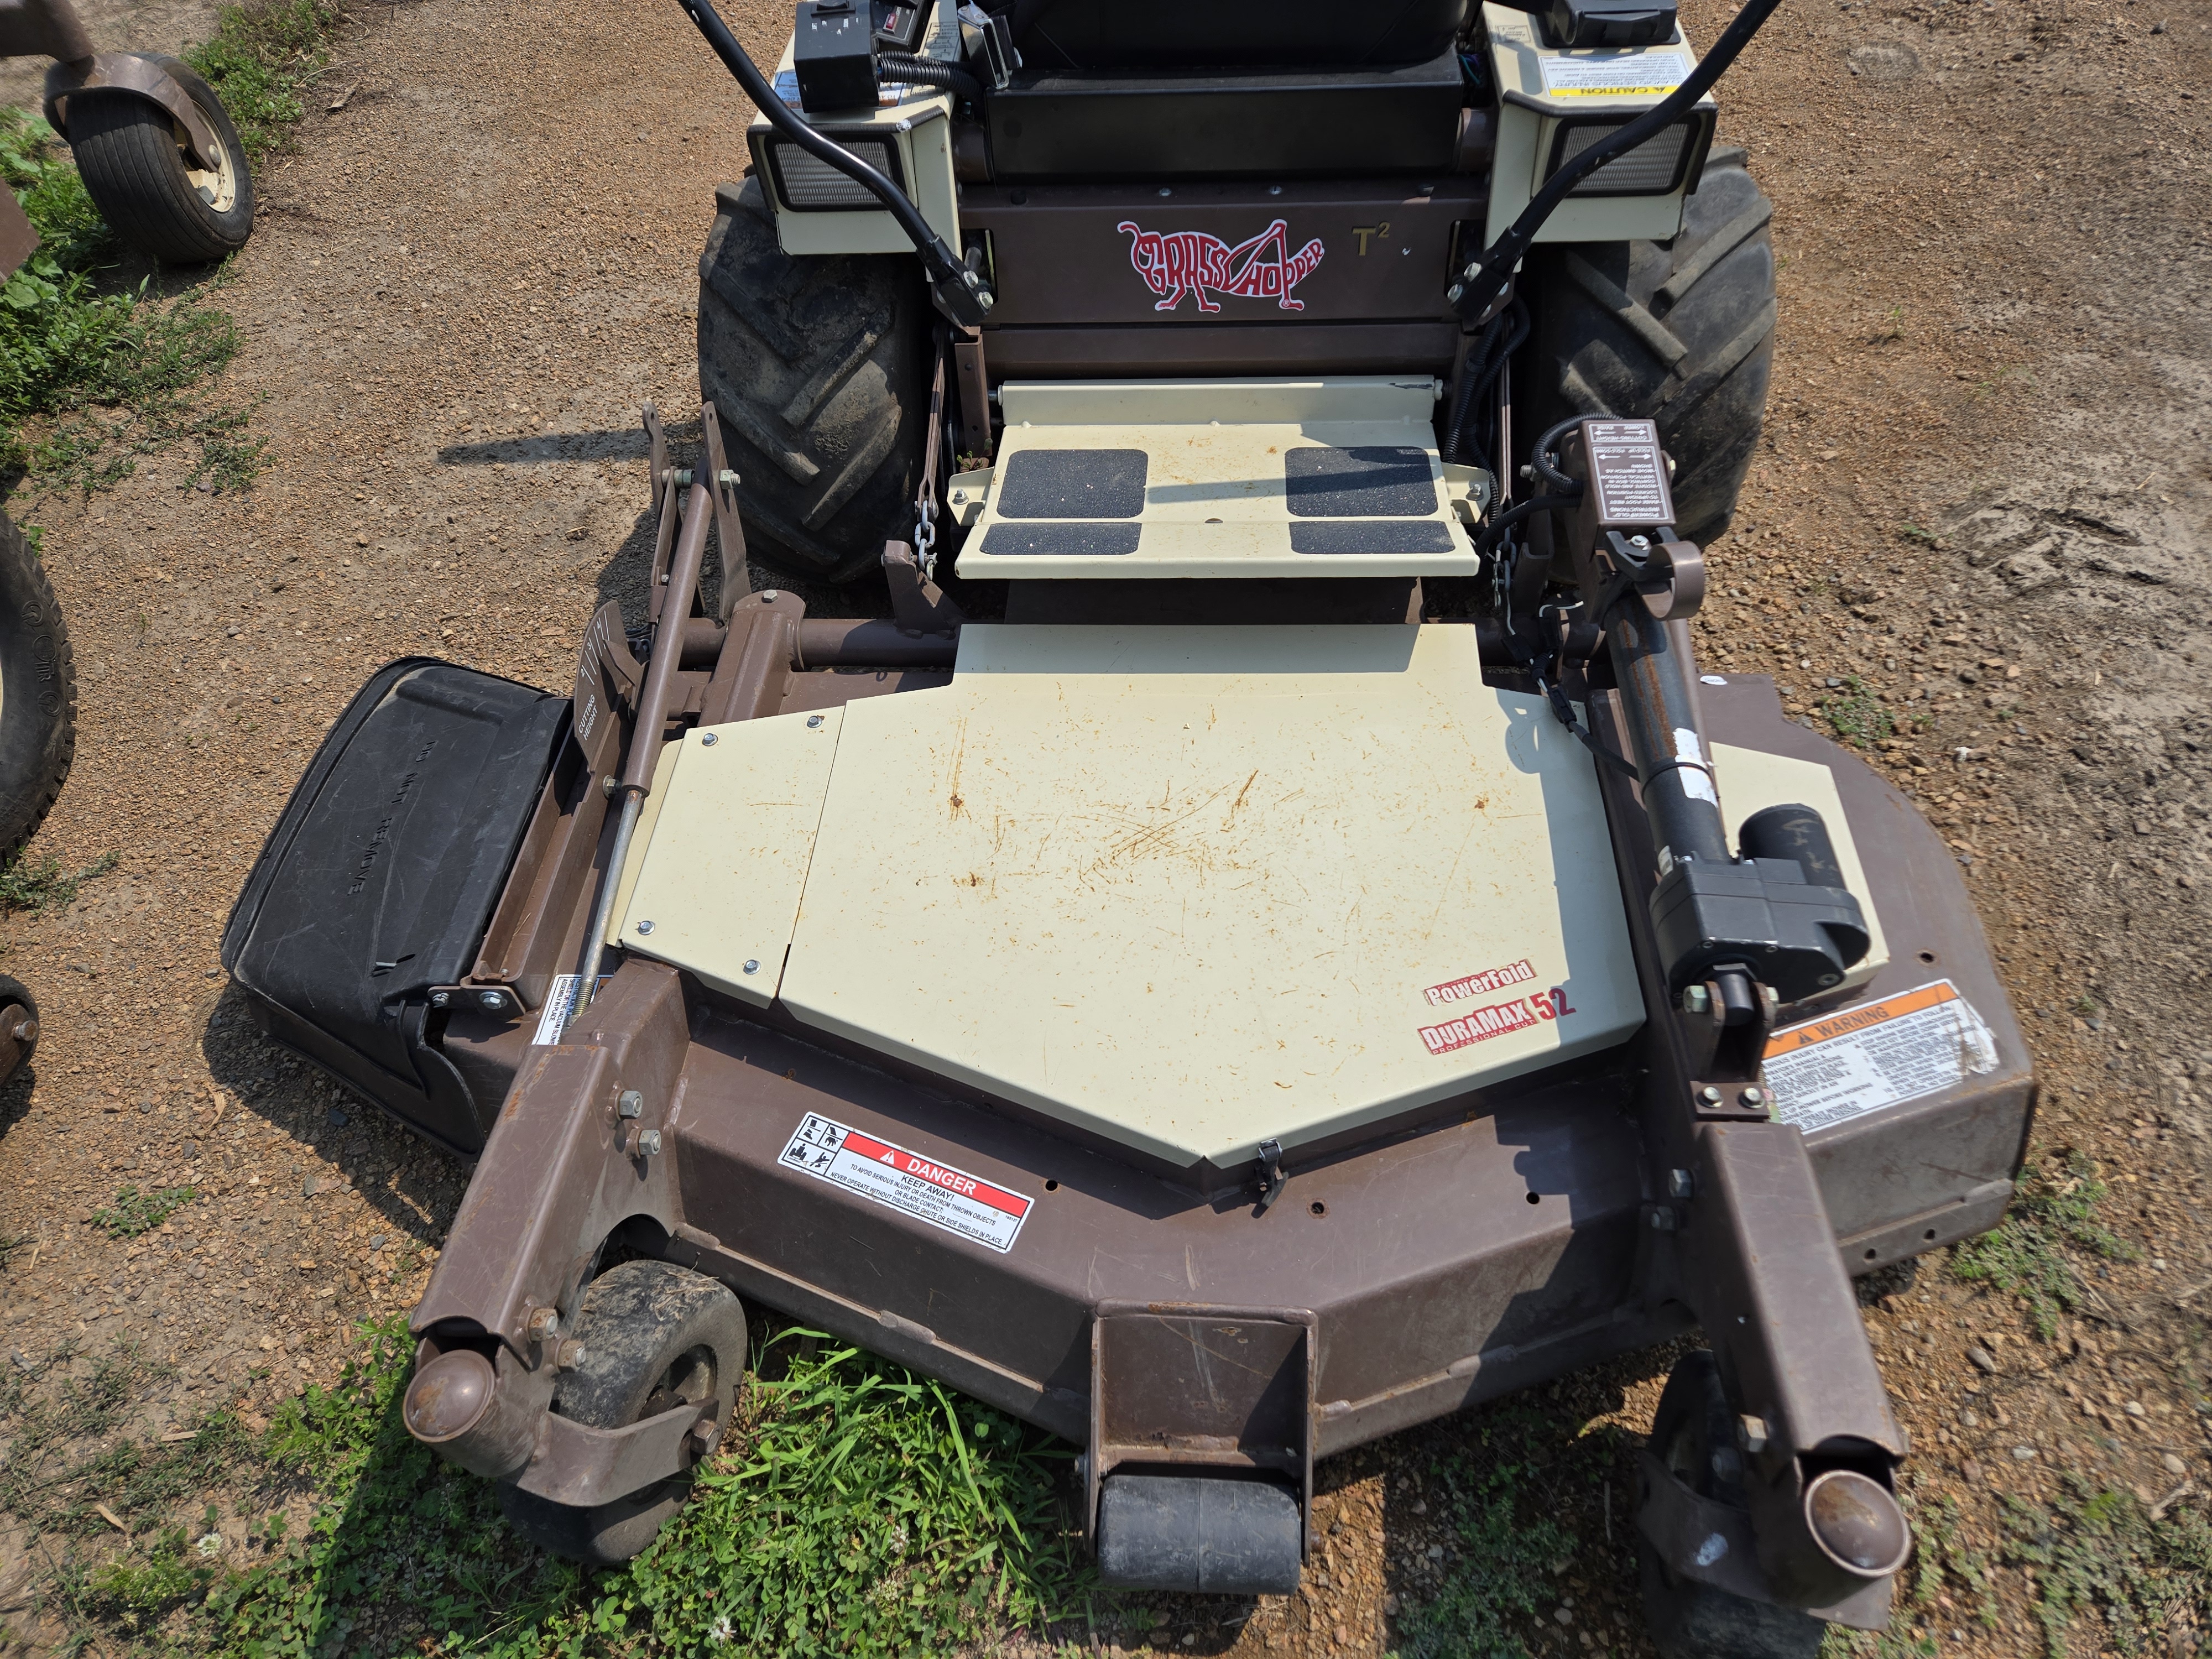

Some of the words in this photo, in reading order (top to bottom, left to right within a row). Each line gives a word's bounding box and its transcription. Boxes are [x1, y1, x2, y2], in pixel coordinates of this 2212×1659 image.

[1579, 85, 1649, 96] CAUTION
[1121, 222, 1323, 309] GRASSHOPPER
[597, 621, 601, 630] 4
[587, 641, 592, 651] 3
[581, 668, 586, 678] 2
[578, 694, 596, 734] CUTTING
[583, 705, 598, 741] HEIGHT
[416, 740, 439, 763] DO
[391, 773, 419, 805] NOT
[347, 816, 395, 896] REMOVE
[556, 979, 568, 1001] ASSEMBLY
[566, 979, 576, 994] SHIELD
[1425, 961, 1535, 1006] PowerFold
[549, 1006, 559, 1022] PLACE.
[555, 1010, 565, 1029] VACUUM
[1528, 987, 1577, 1020] 52
[549, 1029, 559, 1045] BLOWE
[1813, 1005, 1891, 1037] WARNING
[1432, 1027, 1511, 1056] PROFESSIONAL
[1514, 1019, 1536, 1030] CUT
[1760, 1056, 1791, 1070] ERIOUS
[1788, 1047, 1817, 1061] INJURY
[1814, 1042, 1833, 1053] CAN
[1831, 1034, 1860, 1047] RESULT
[1859, 1027, 1882, 1038] FROM
[1881, 1018, 1913, 1031] FAILURE
[900, 1175, 926, 1190] KEEP
[925, 1184, 955, 1201] AWAY!
[906, 1157, 978, 1196] DANGER
[829, 1171, 848, 1183] NEVER
[846, 1177, 870, 1192] OPERATE
[868, 1186, 893, 1201] WITHOUT
[890, 1195, 921, 1212] DISCHARGE
[919, 1207, 938, 1218] CHUTE
[936, 1213, 946, 1222] OR
[945, 1217, 958, 1227] SIDE
[956, 1221, 980, 1235] SHIELDS
[984, 1232, 1004, 1245] PLACE.
[856, 1166, 873, 1177] AVOID
[871, 1172, 894, 1186] SERIOUS
[893, 1181, 912, 1192] INJURY
[910, 1187, 920, 1196] OR
[918, 1191, 936, 1202] DEATH
[935, 1197, 951, 1208] FROM
[950, 1203, 973, 1217] THROWN
[972, 1212, 997, 1226] OBJECTS
[893, 1189, 903, 1197] OR
[901, 1192, 919, 1203] BLADE
[916, 1198, 945, 1214] CONTACT;
